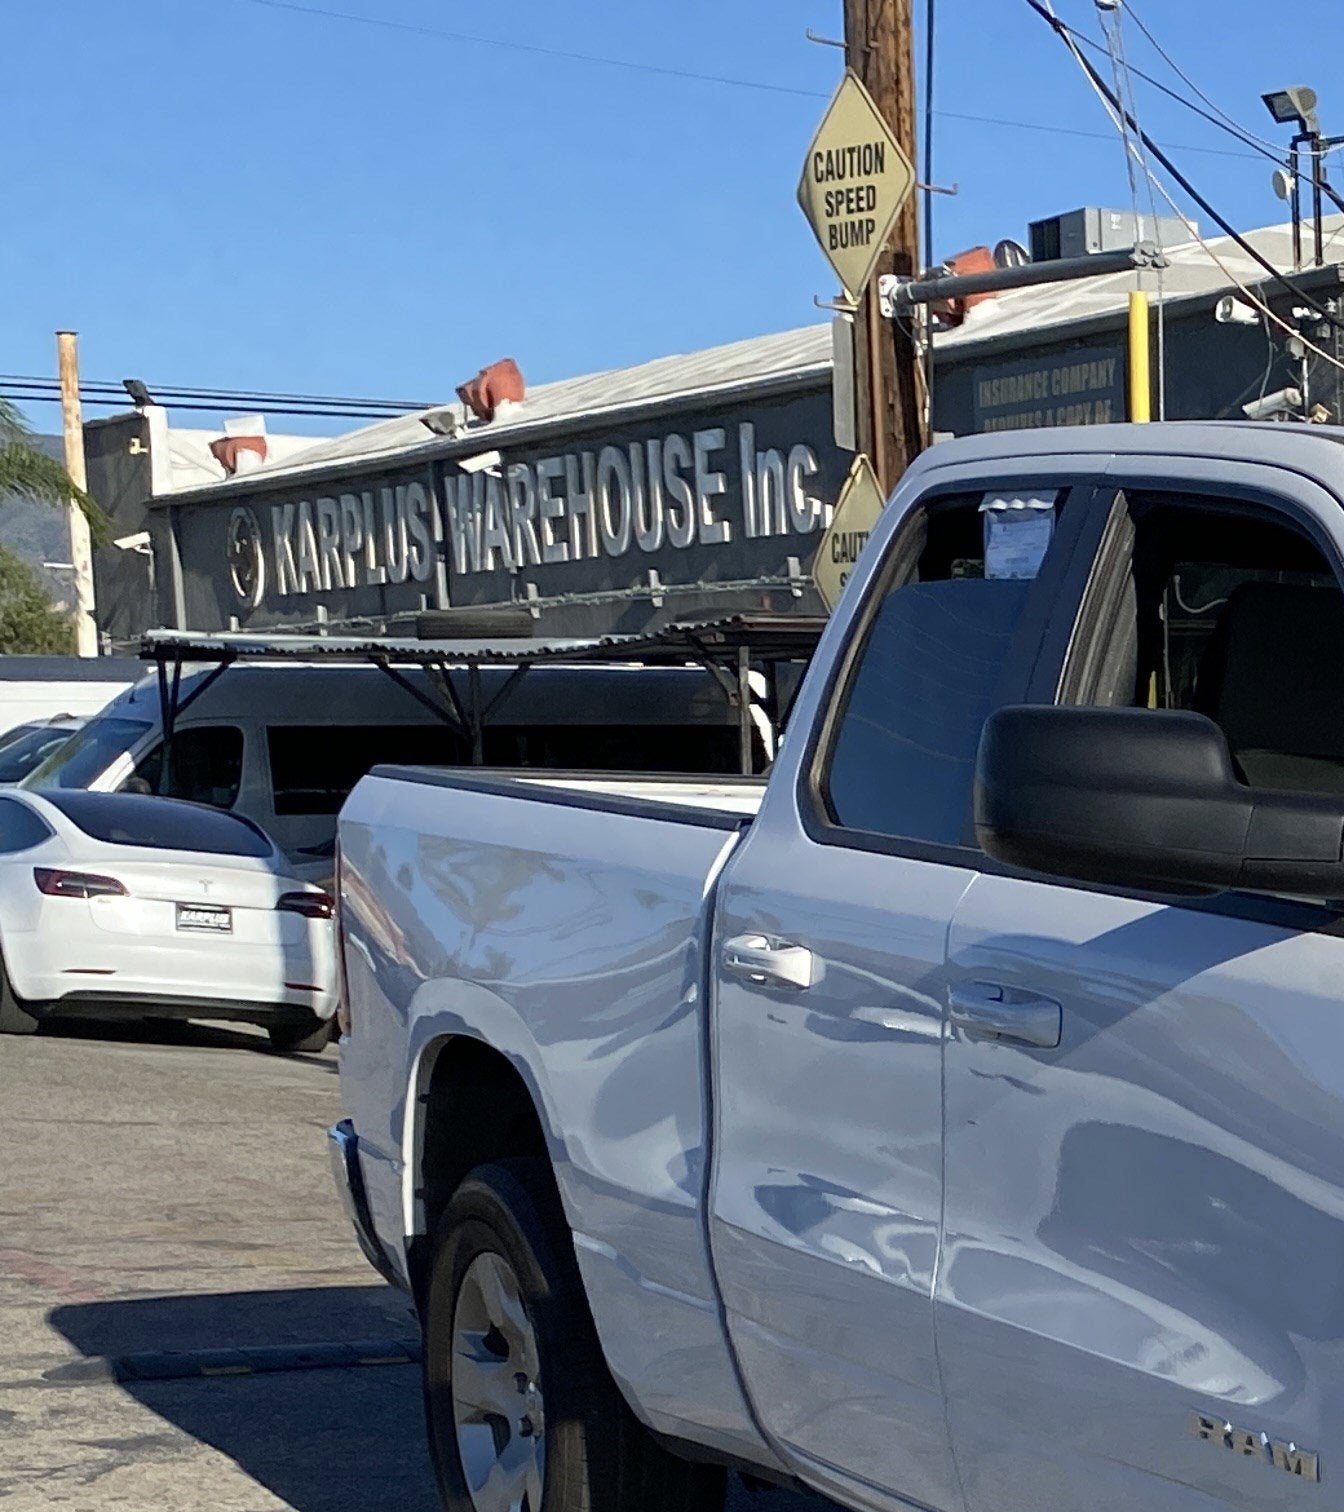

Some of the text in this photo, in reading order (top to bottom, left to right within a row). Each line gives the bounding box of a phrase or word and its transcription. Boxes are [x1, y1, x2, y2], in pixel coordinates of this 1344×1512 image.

[813, 141, 885, 183] CAUTION
[825, 185, 876, 218] SPEED
[828, 218, 875, 250] BUMP
[979, 358, 1116, 408] INSURANCE COMPANY
[271, 422, 834, 595] KARPLUS WAREHOUSE Inc.
[831, 531, 870, 563] CAUT
[1187, 1407, 1321, 1483] RAM
